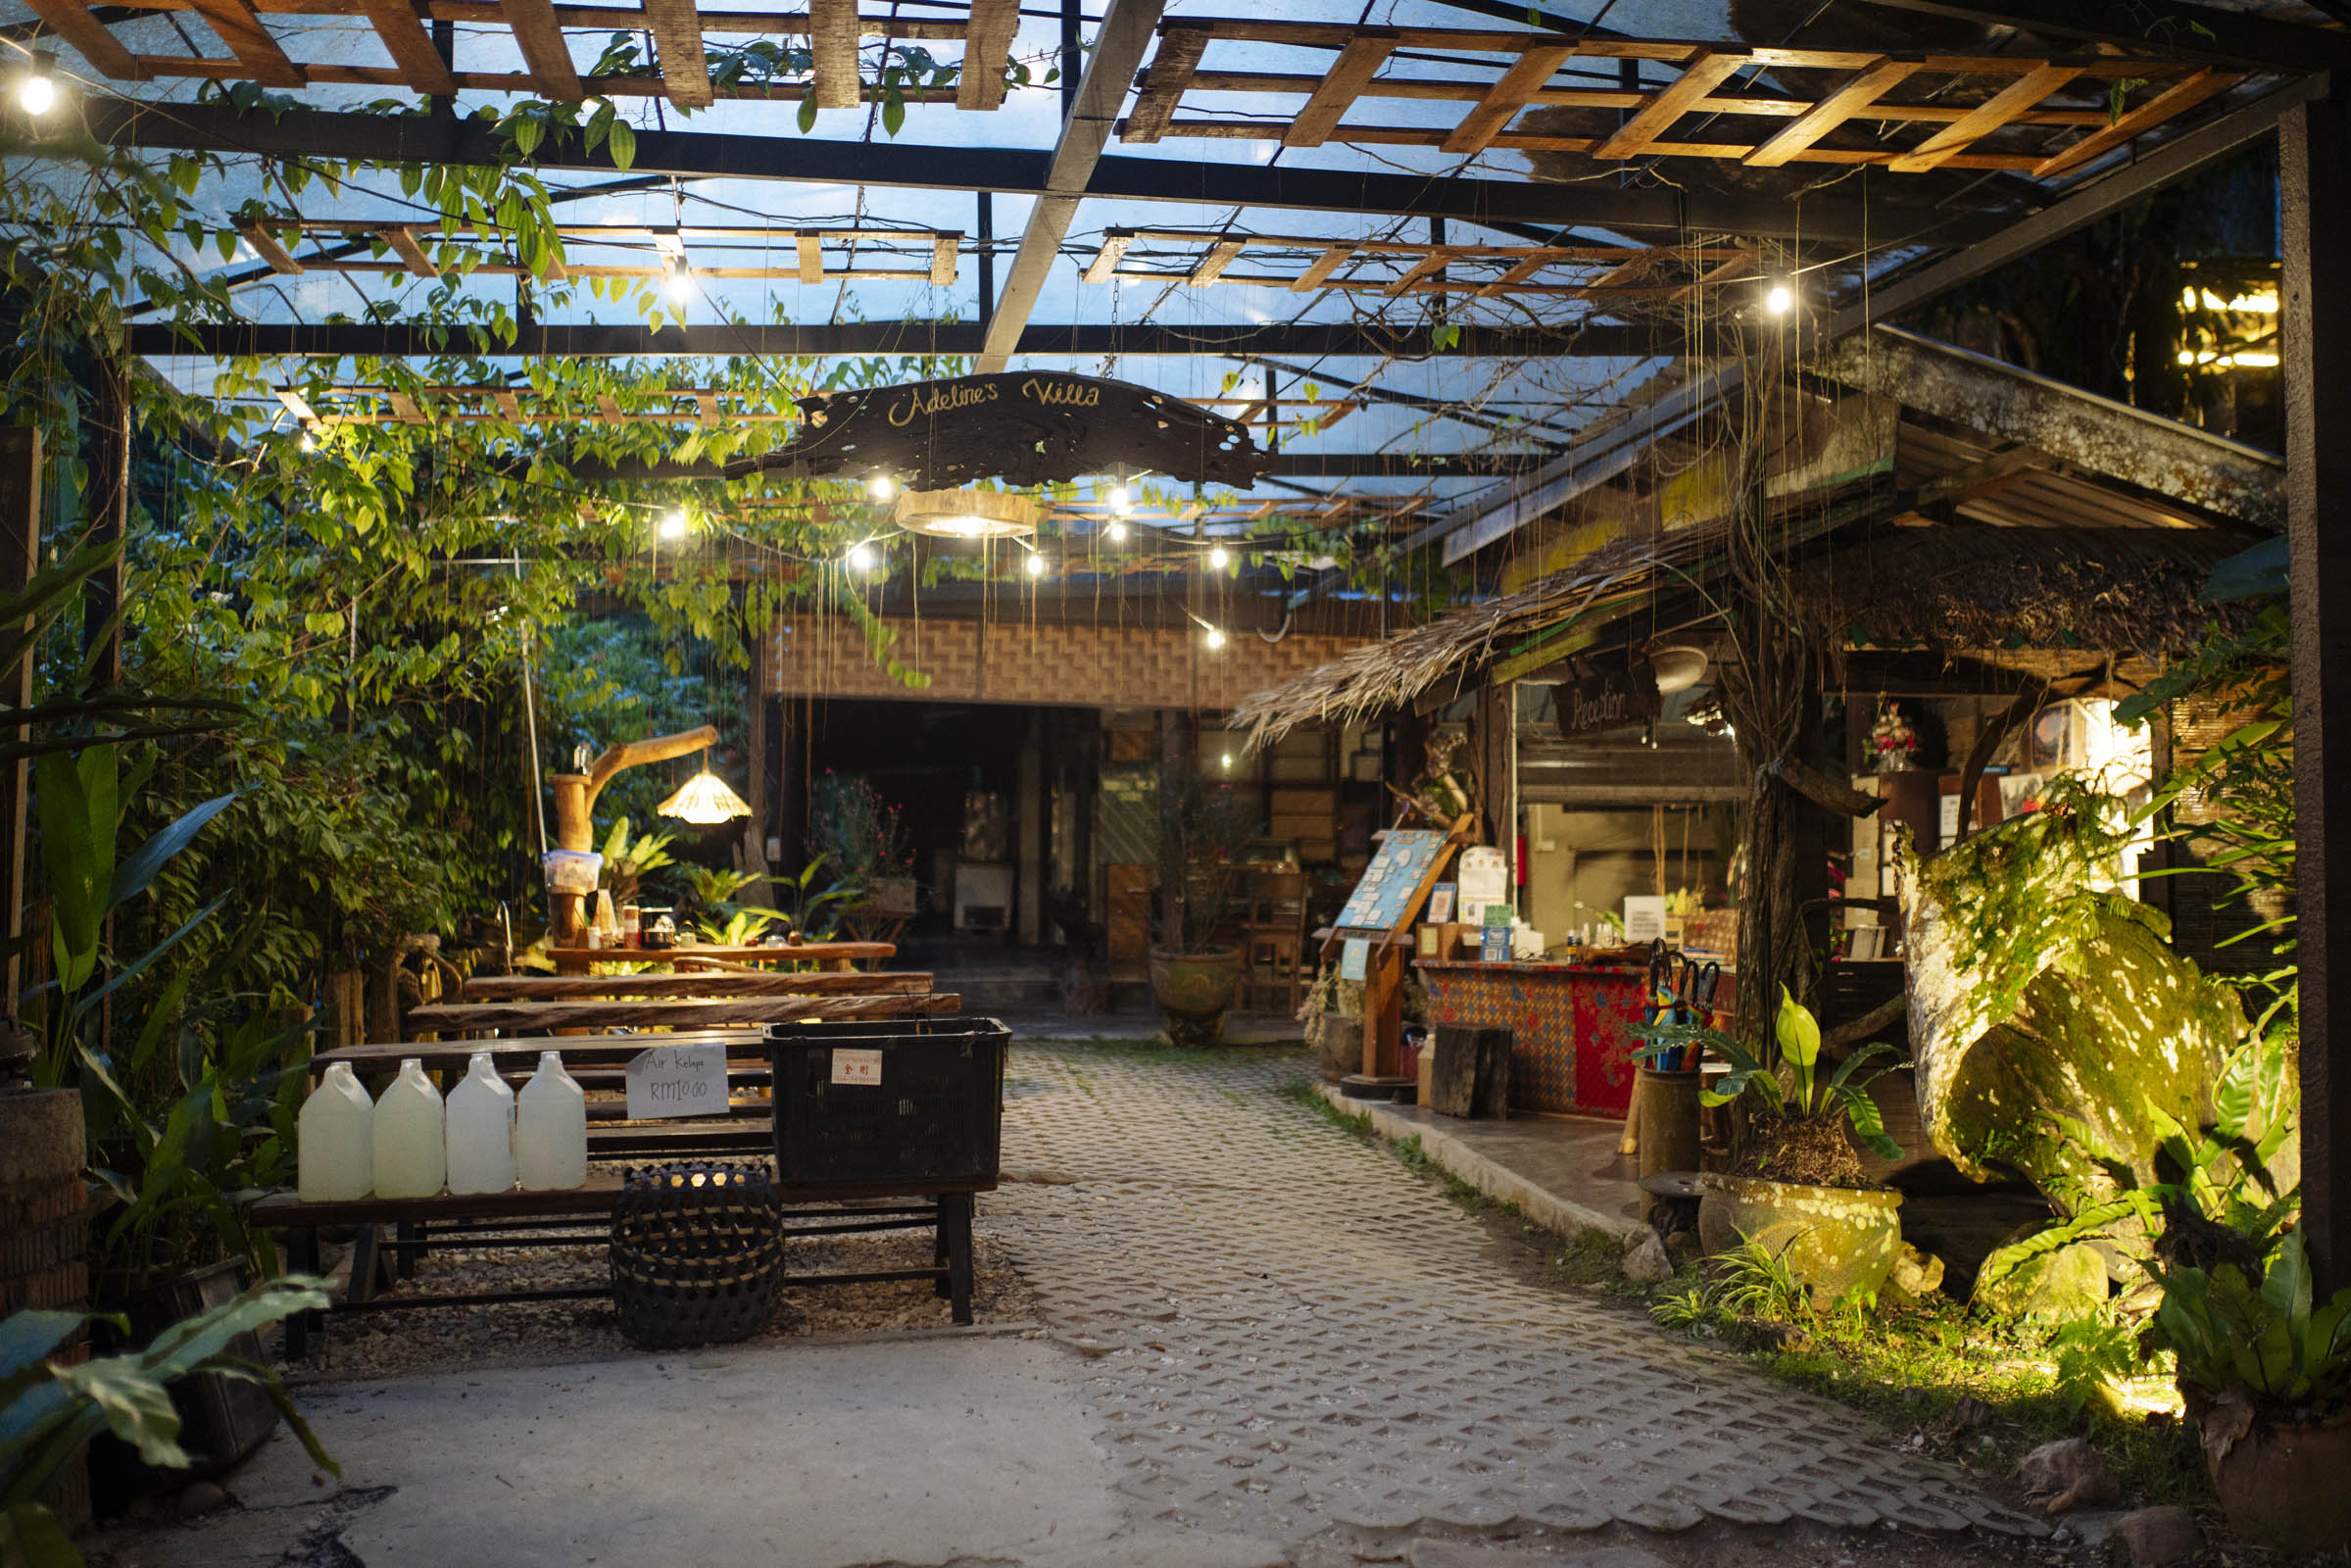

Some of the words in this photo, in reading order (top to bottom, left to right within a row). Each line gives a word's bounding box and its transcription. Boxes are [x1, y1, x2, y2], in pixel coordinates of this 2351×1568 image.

[887, 382, 999, 427] Adeline's
[1021, 377, 1102, 407] Villa
[645, 1051, 667, 1070] Air
